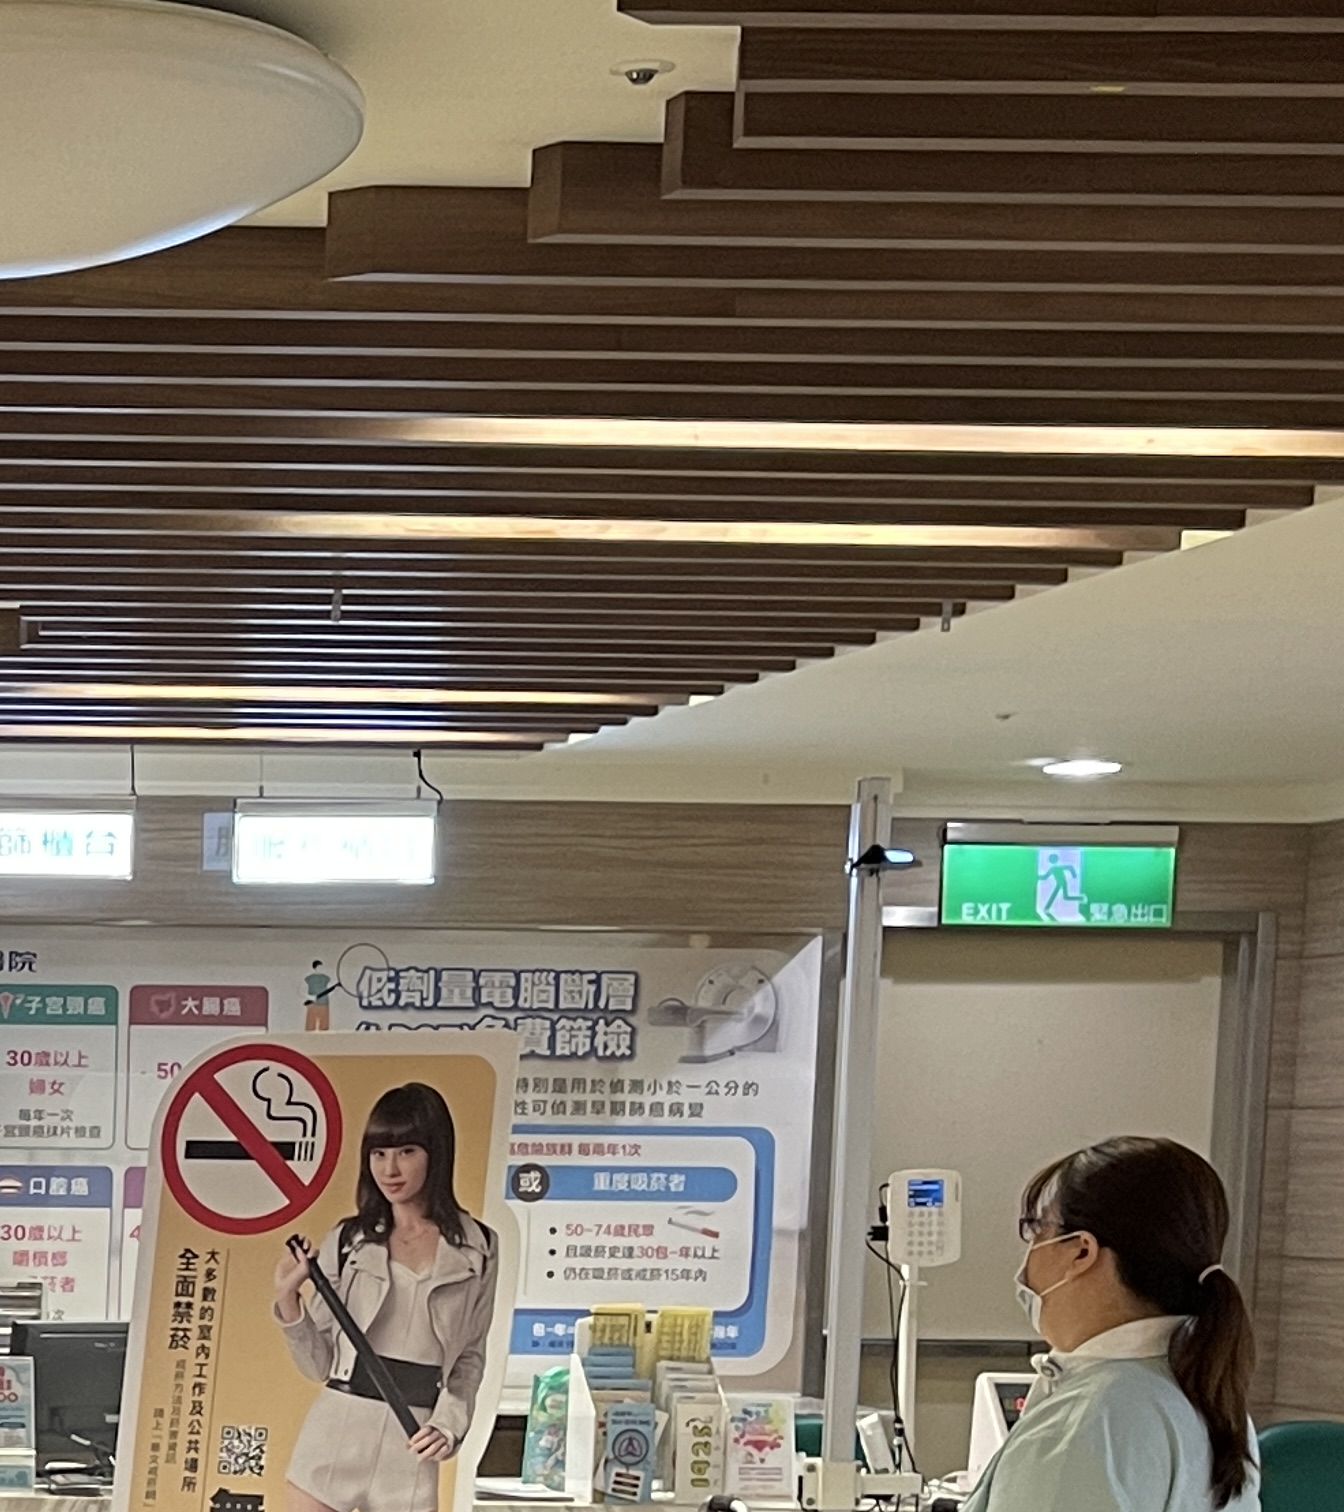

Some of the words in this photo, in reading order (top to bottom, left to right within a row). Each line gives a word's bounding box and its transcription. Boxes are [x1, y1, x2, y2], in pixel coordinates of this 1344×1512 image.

[962, 902, 1012, 921] EXIT
[1090, 902, 1167, 923] 緊急出口
[358, 966, 637, 1011] 低劑量電腦斷層
[24, 996, 106, 1015] 子宮頸癌
[181, 997, 241, 1016] 大腸癌
[6, 1050, 89, 1067] 30歲以上
[28, 1078, 65, 1096] 婦女
[29, 1178, 89, 1196] 口腔癌
[519, 1172, 541, 1192] 或
[593, 1172, 686, 1192] 重度吸菸者
[0, 1225, 82, 1242] 30歲以上
[168, 1248, 200, 1350] 全面禁菸
[181, 1249, 220, 1493] 大多數的室內工作及公共場所
